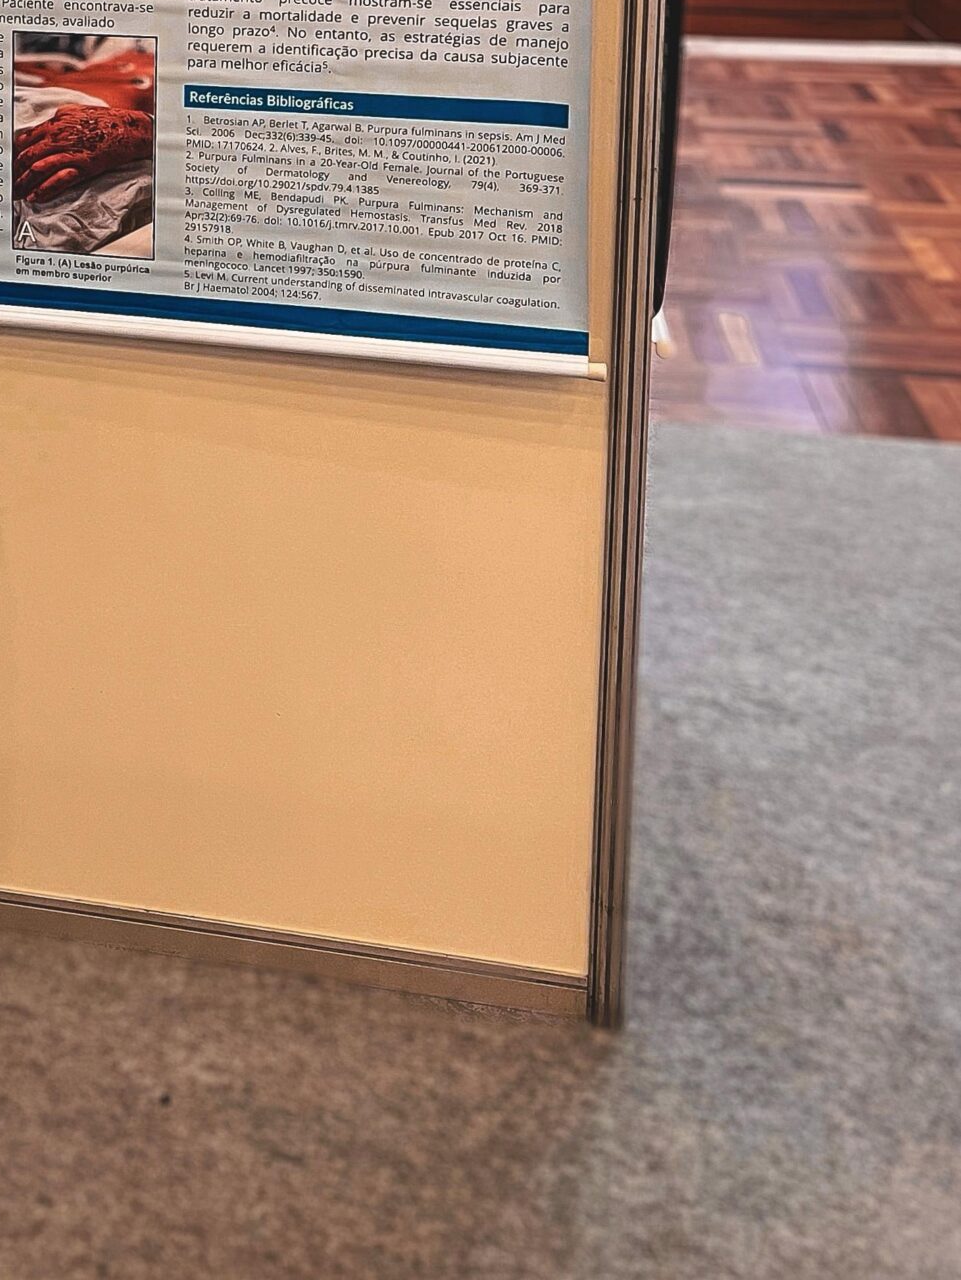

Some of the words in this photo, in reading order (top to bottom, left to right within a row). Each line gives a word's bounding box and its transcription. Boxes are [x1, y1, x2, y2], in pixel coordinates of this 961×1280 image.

[190, 91, 263, 106] Referências
[267, 95, 354, 110] Bibliográficas
[204, 116, 249, 126] Betrosian
[252, 119, 266, 128] AP,
[270, 119, 298, 129] Berlet
[301, 121, 308, 130] T,
[312, 122, 351, 132] Agarwal
[355, 124, 364, 132] B.
[368, 124, 408, 136] Purpura
[412, 126, 462, 138] fulminans
[466, 131, 474, 139] in
[478, 132, 512, 142] sepsis.
[516, 132, 533, 142] Am
[543, 134, 565, 145] Med
[18, 222, 36, 242] A
[16, 255, 45, 266] Figura
[48, 258, 55, 266] 1.
[58, 259, 71, 269] (A)
[74, 260, 102, 270] Lesão
[105, 264, 150, 274] purpúrica
[32, 270, 70, 278] membro
[72, 273, 112, 282] superior
